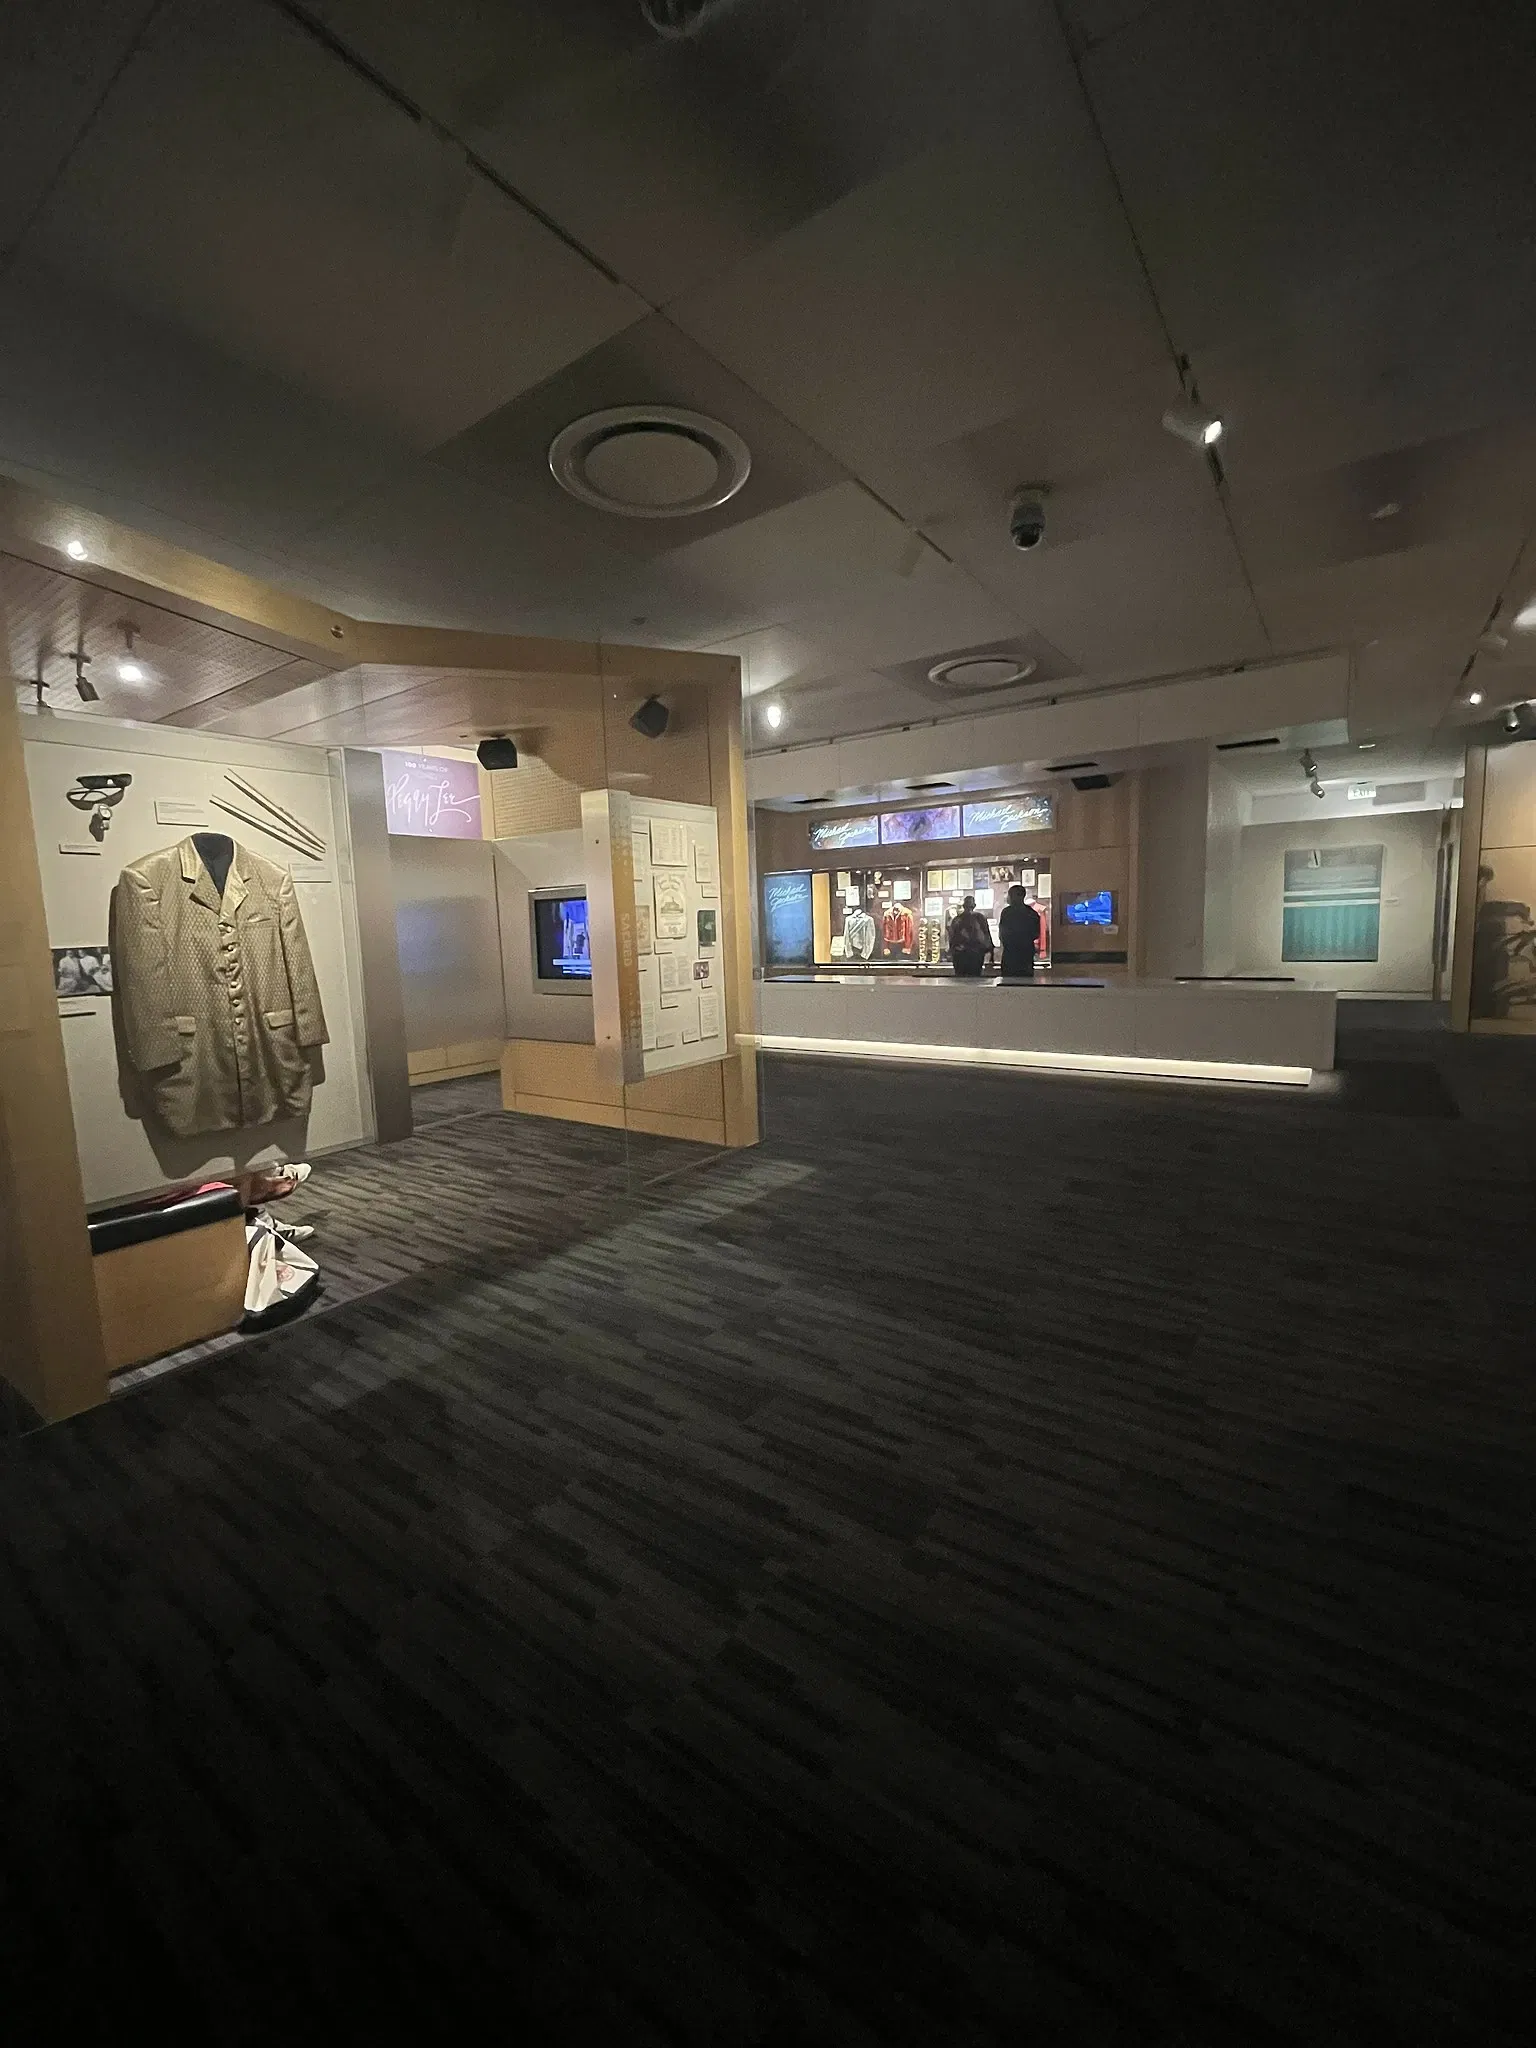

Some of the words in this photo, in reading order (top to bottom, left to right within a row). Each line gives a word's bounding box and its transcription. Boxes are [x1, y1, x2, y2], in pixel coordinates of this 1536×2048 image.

[970, 805, 1015, 824] Michael
[999, 808, 1049, 832] Jackson
[815, 823, 851, 841] Michael
[839, 826, 876, 846] Jackson
[769, 883, 807, 900] Michael
